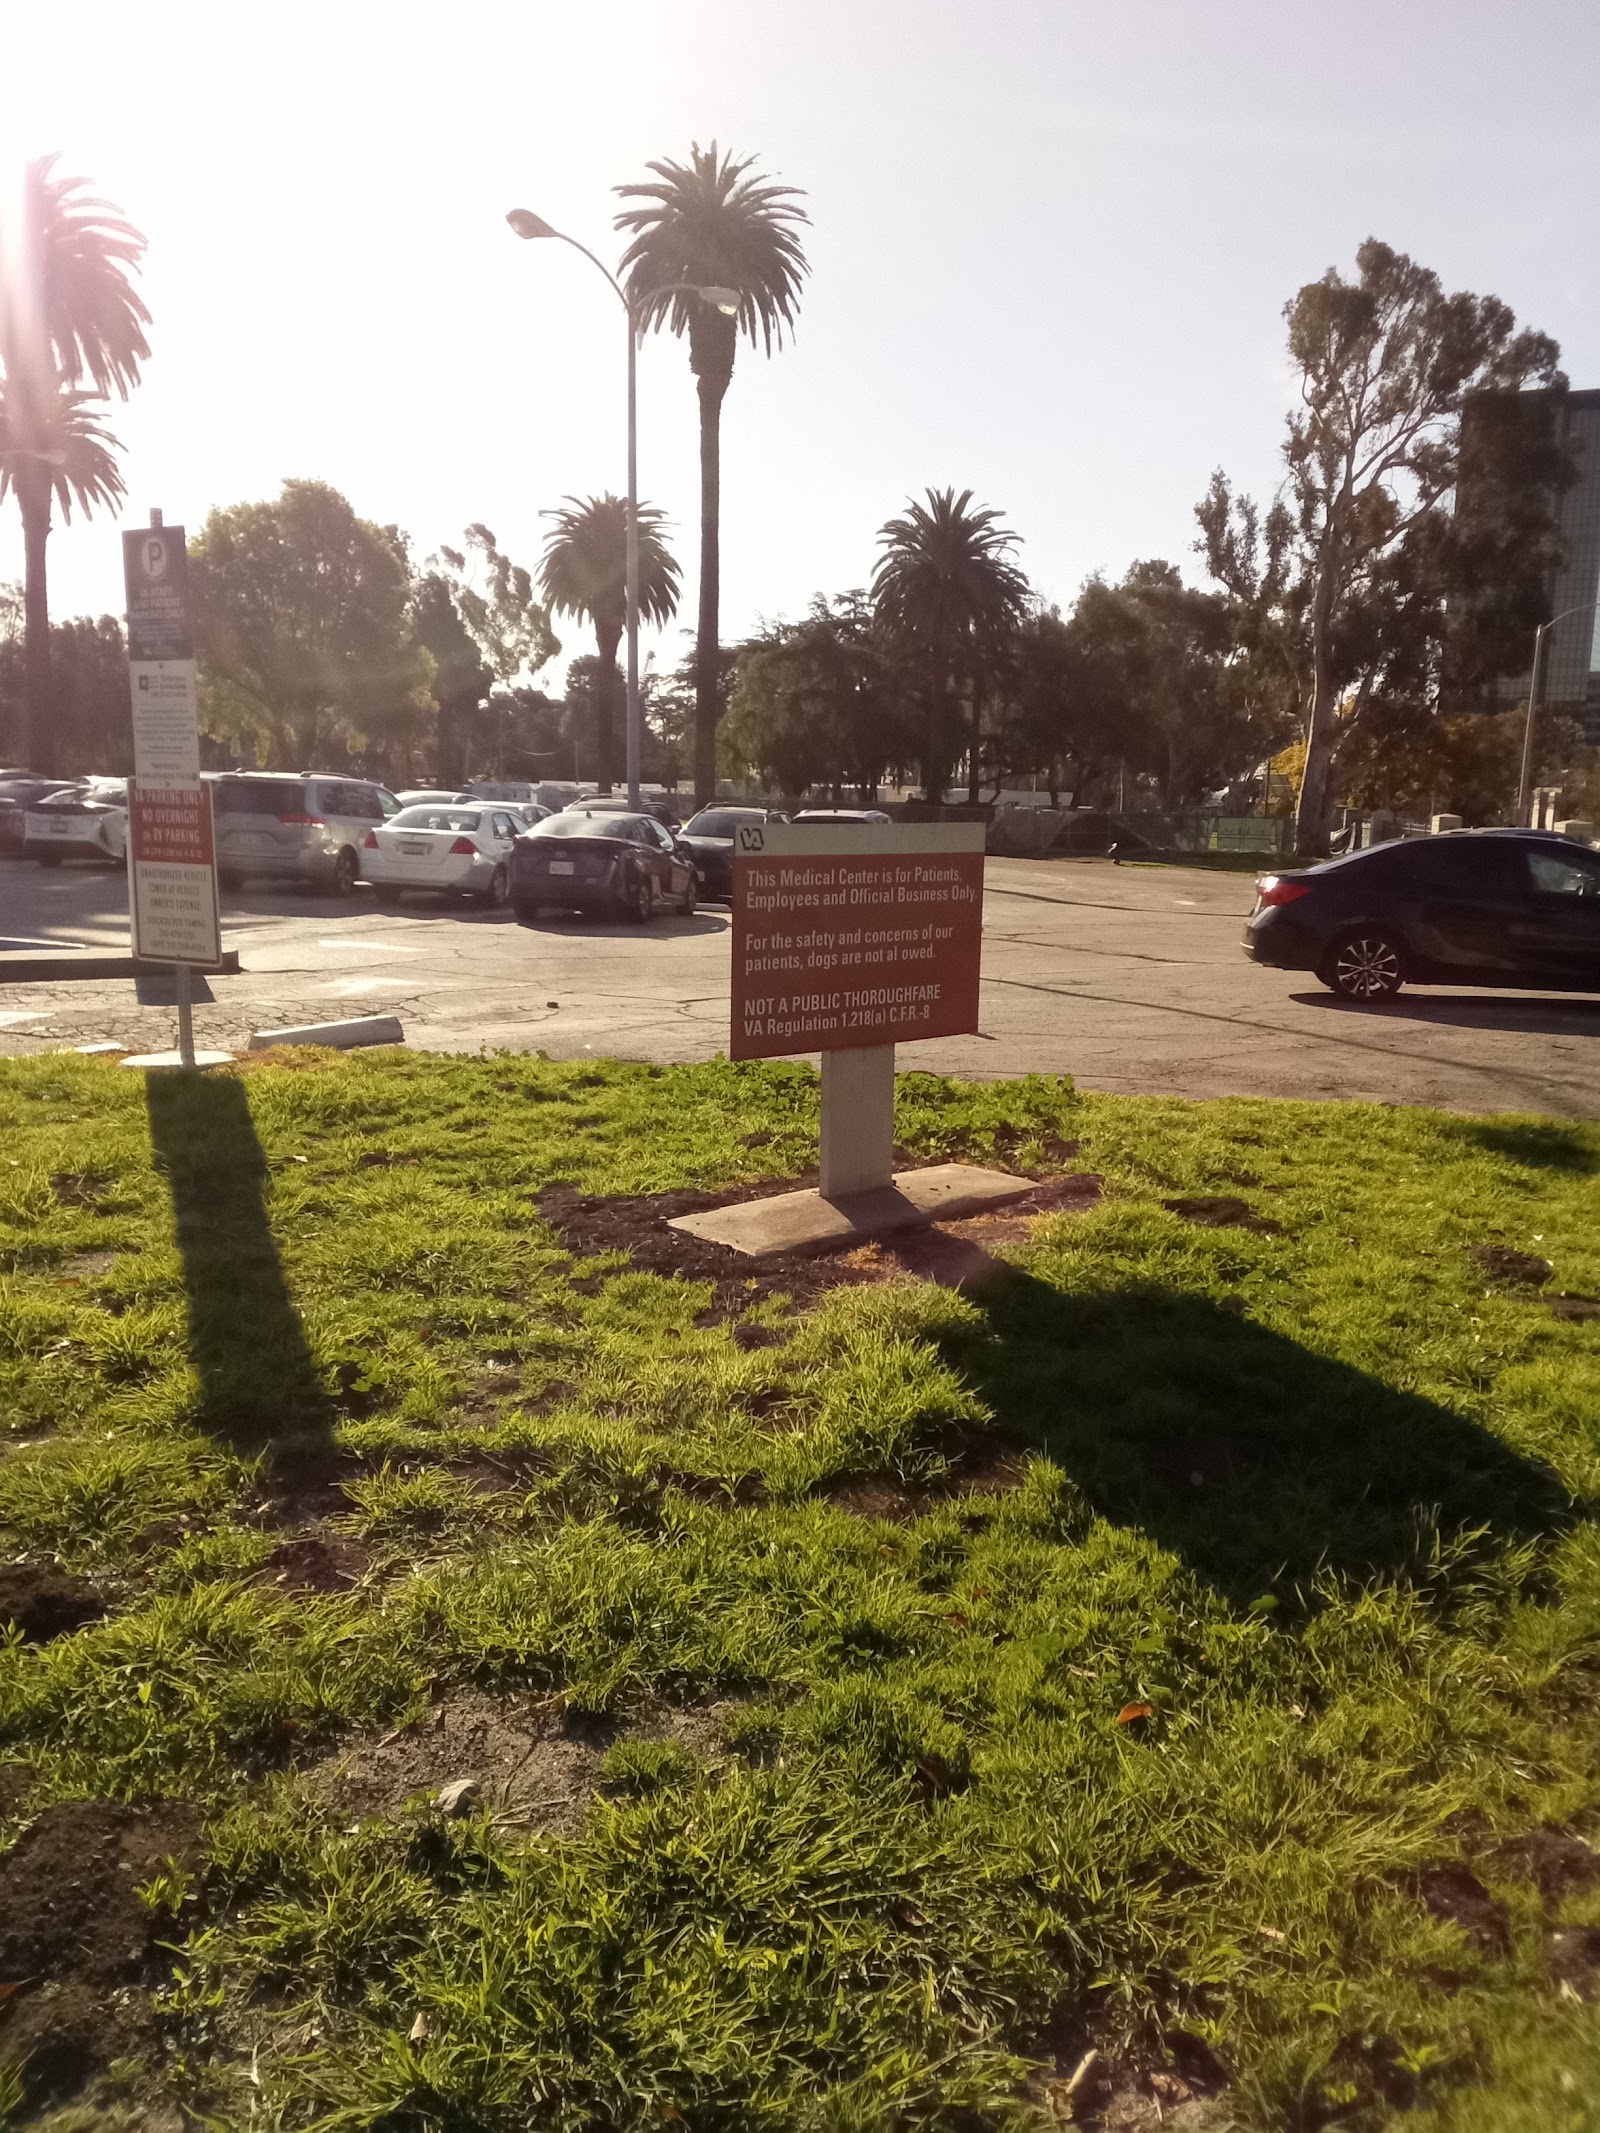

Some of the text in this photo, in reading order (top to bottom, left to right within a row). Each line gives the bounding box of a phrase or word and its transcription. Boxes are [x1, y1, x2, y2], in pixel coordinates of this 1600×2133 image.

[147, 541, 162, 571] P
[146, 790, 181, 804] PARKING
[183, 791, 204, 806] ONLY
[142, 808, 199, 824] NO OVERNIGHT
[152, 827, 163, 841] RV
[165, 828, 201, 844] PARKING
[740, 827, 764, 851] VA
[184, 870, 207, 882] VEHICLE
[747, 865, 962, 887] This Medical Center is for Patients,
[176, 885, 200, 896] VEHICLE
[746, 890, 819, 912] Employees
[824, 889, 846, 906] and
[850, 887, 894, 904] Official
[898, 885, 948, 903] Business
[175, 899, 200, 911] EXPENSE
[746, 924, 953, 951] For the safety and concerns of our
[745, 953, 804, 976] patients,
[808, 951, 838, 970] dogs
[841, 949, 861, 964] are
[865, 948, 884, 963] not
[744, 984, 941, 1016] NOT A PUBLIC THOROUGHFARE
[744, 1019, 763, 1037] VA
[767, 1012, 837, 1037] Regulation
